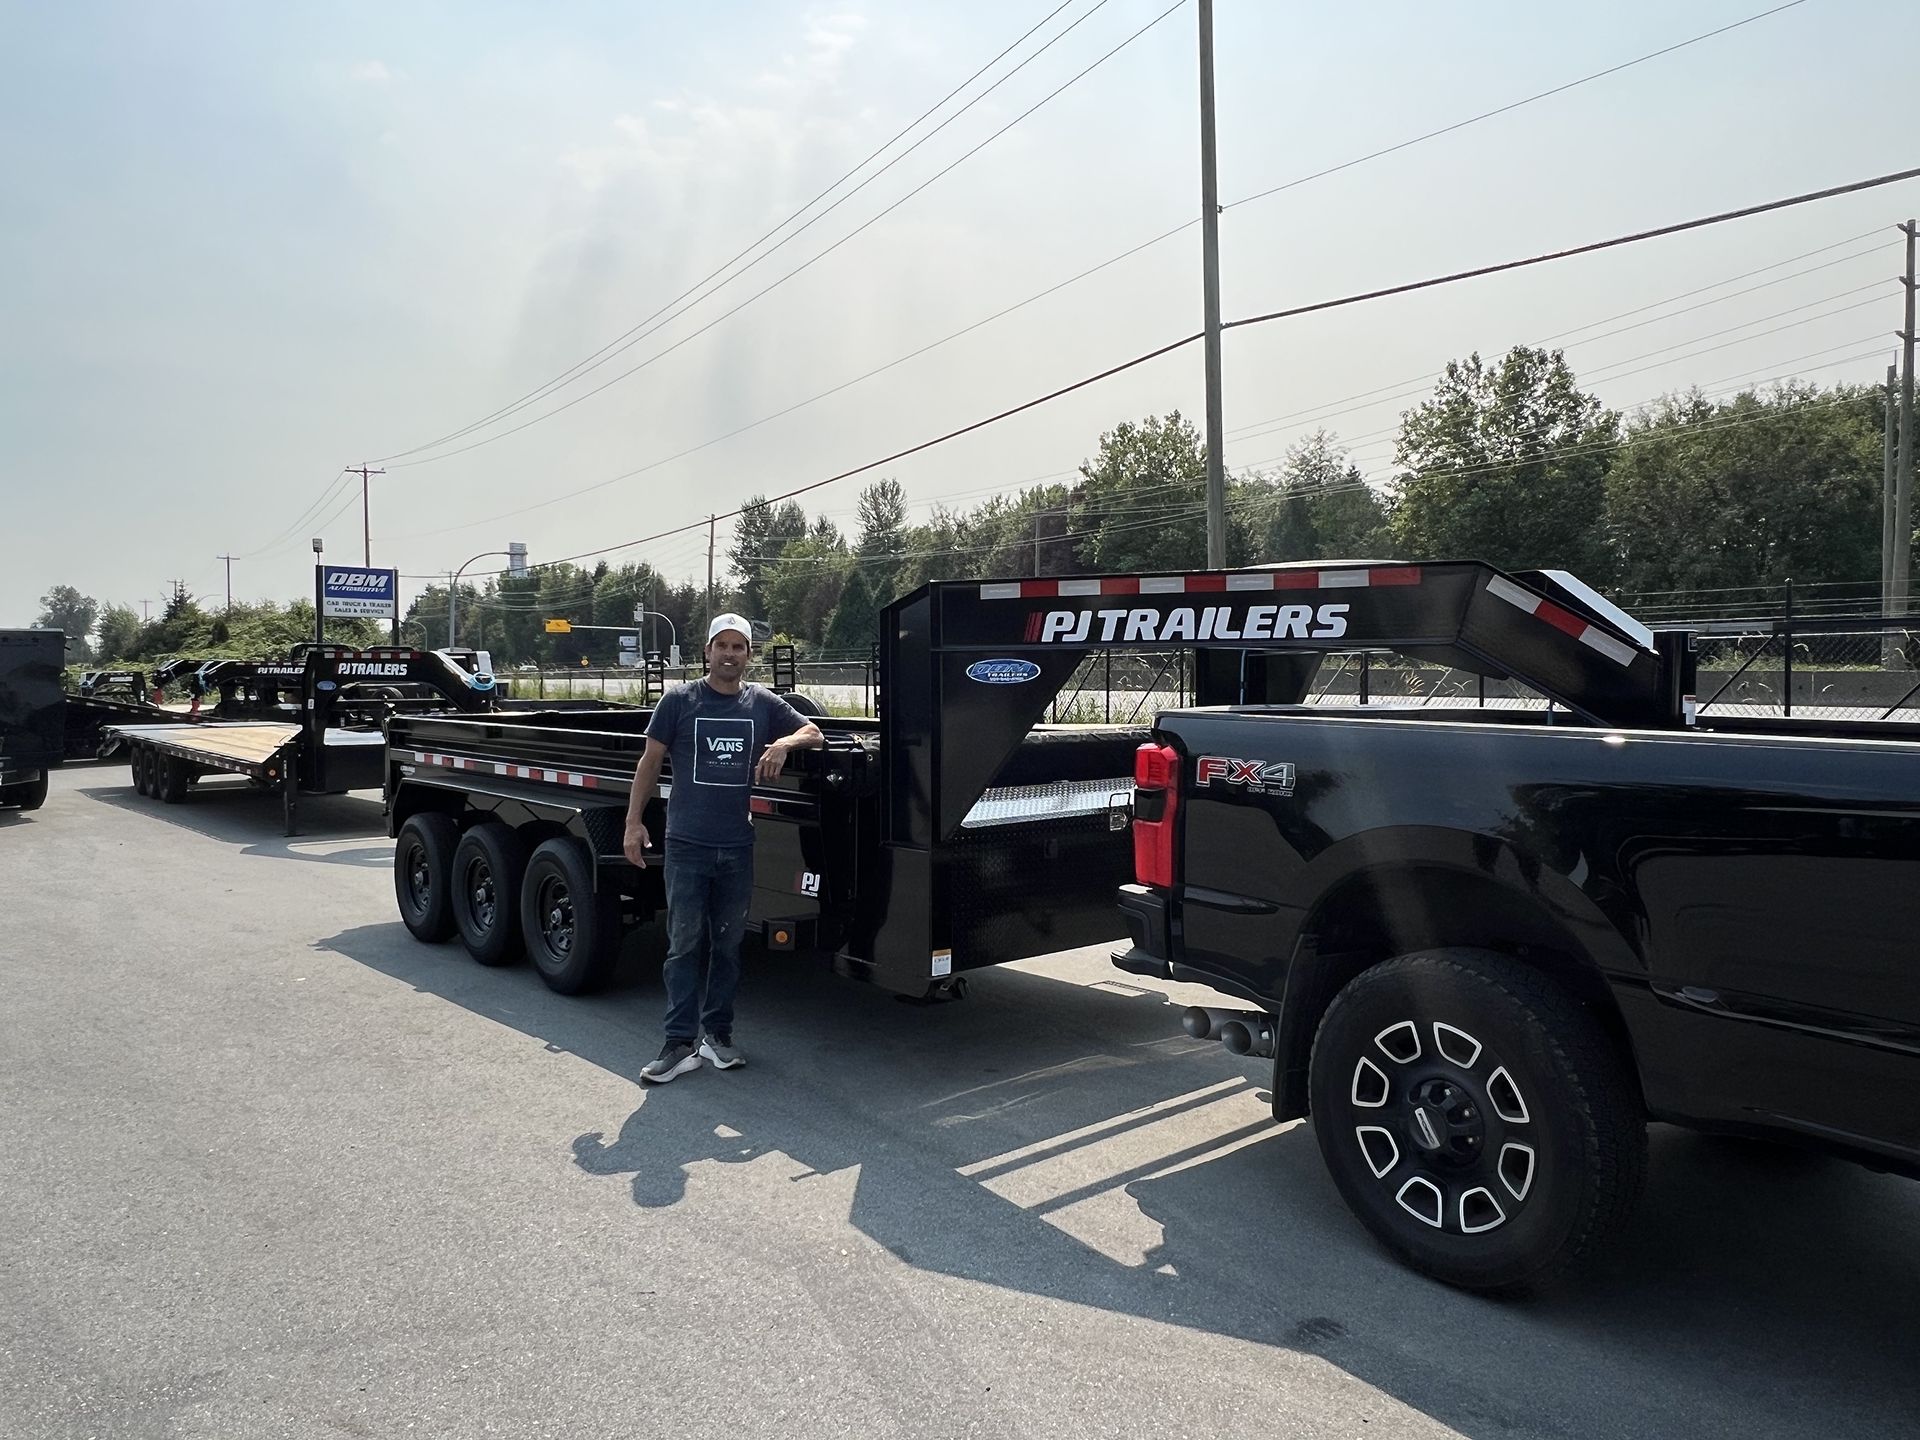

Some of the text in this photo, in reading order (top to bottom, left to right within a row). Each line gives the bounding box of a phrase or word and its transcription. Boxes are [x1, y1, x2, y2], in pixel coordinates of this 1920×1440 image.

[327, 573, 389, 586] DBM
[1041, 604, 1350, 642] PJ TRAILERS
[338, 663, 408, 676] PJ TRAILERS
[706, 737, 744, 752] VANS
[1196, 756, 1296, 790] FX4
[801, 872, 820, 892] PJ
